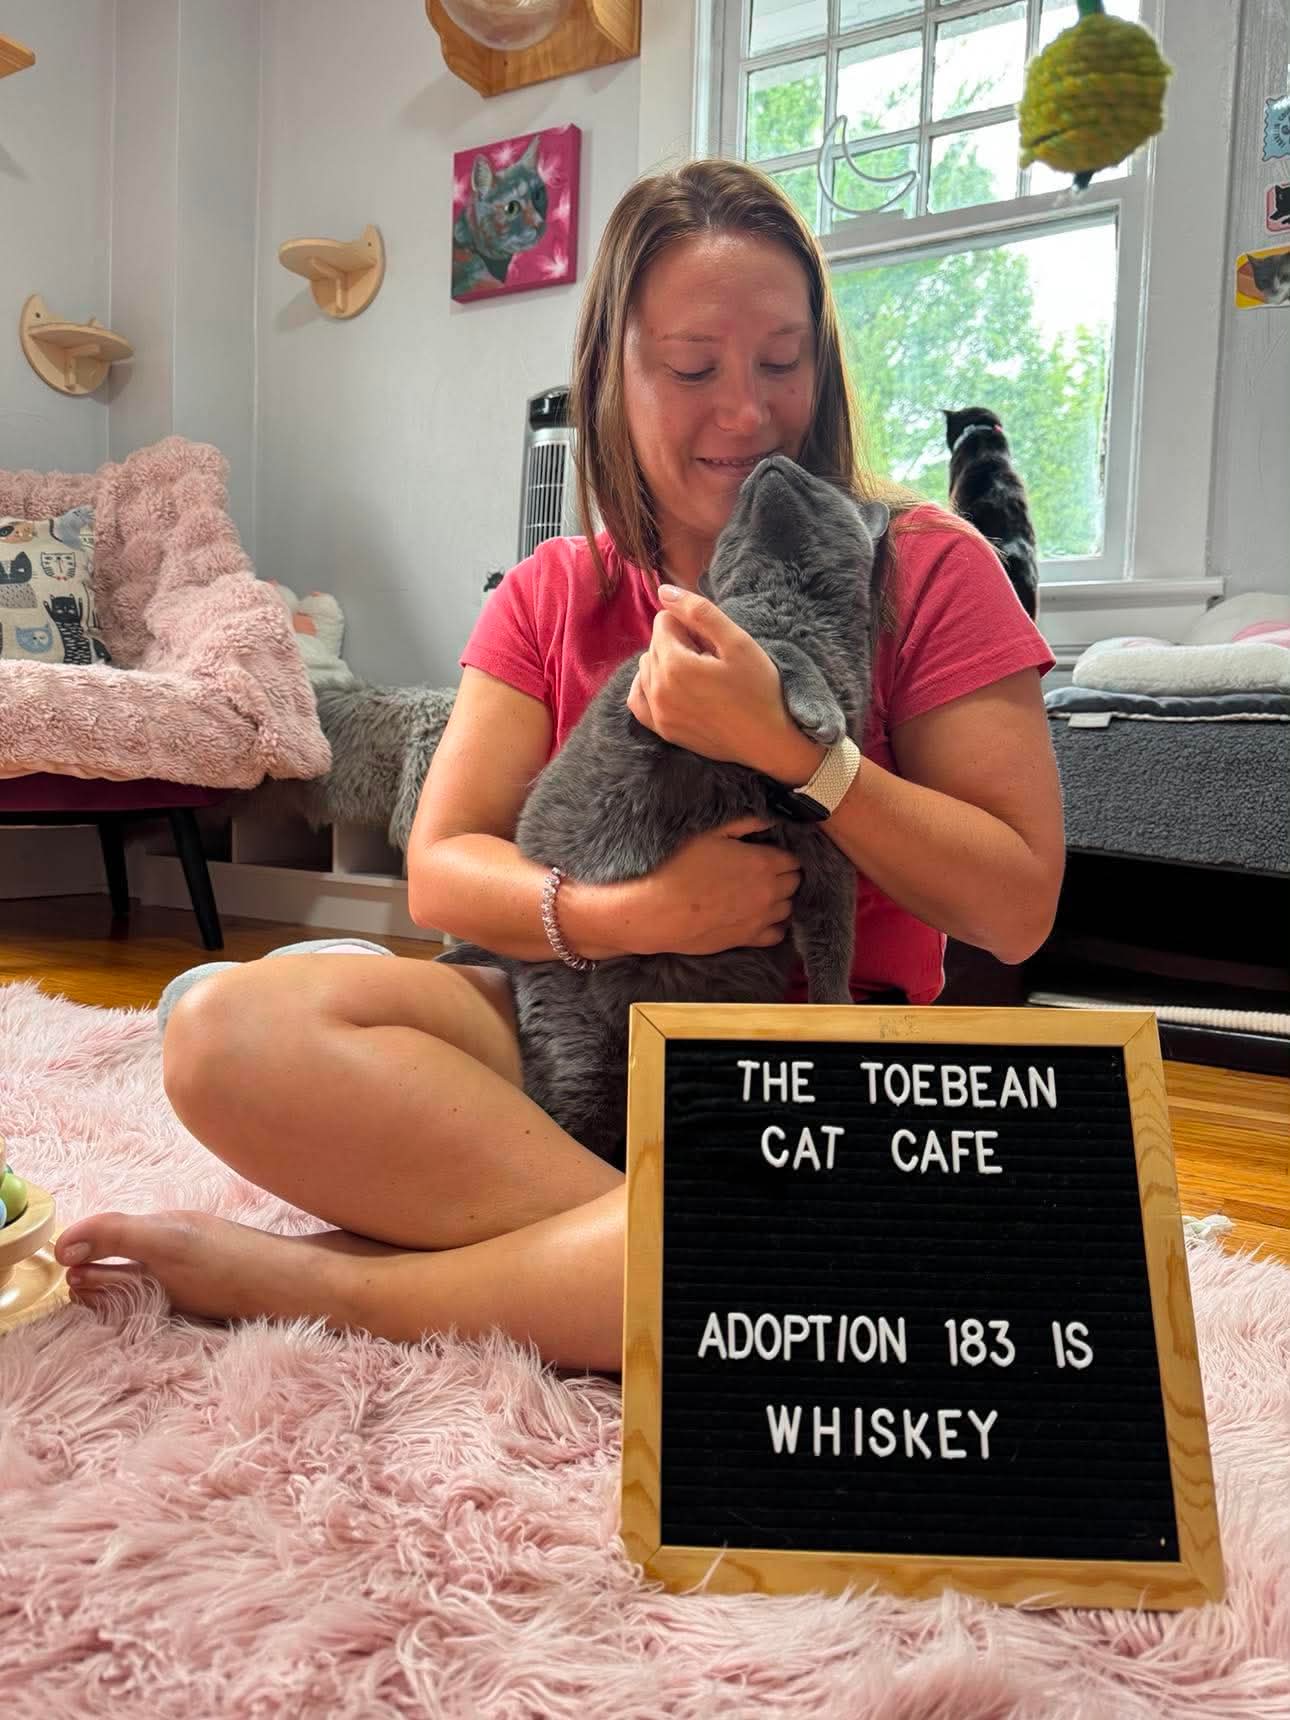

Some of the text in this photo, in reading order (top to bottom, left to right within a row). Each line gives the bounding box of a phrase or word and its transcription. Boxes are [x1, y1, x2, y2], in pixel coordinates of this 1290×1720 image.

[737, 1060, 1058, 1108] THE TOEBEAN
[761, 1125, 1003, 1174] CAT CAFE
[698, 1312, 1094, 1369] ADOPTION 183 IS
[766, 1404, 998, 1459] WHISKEY
